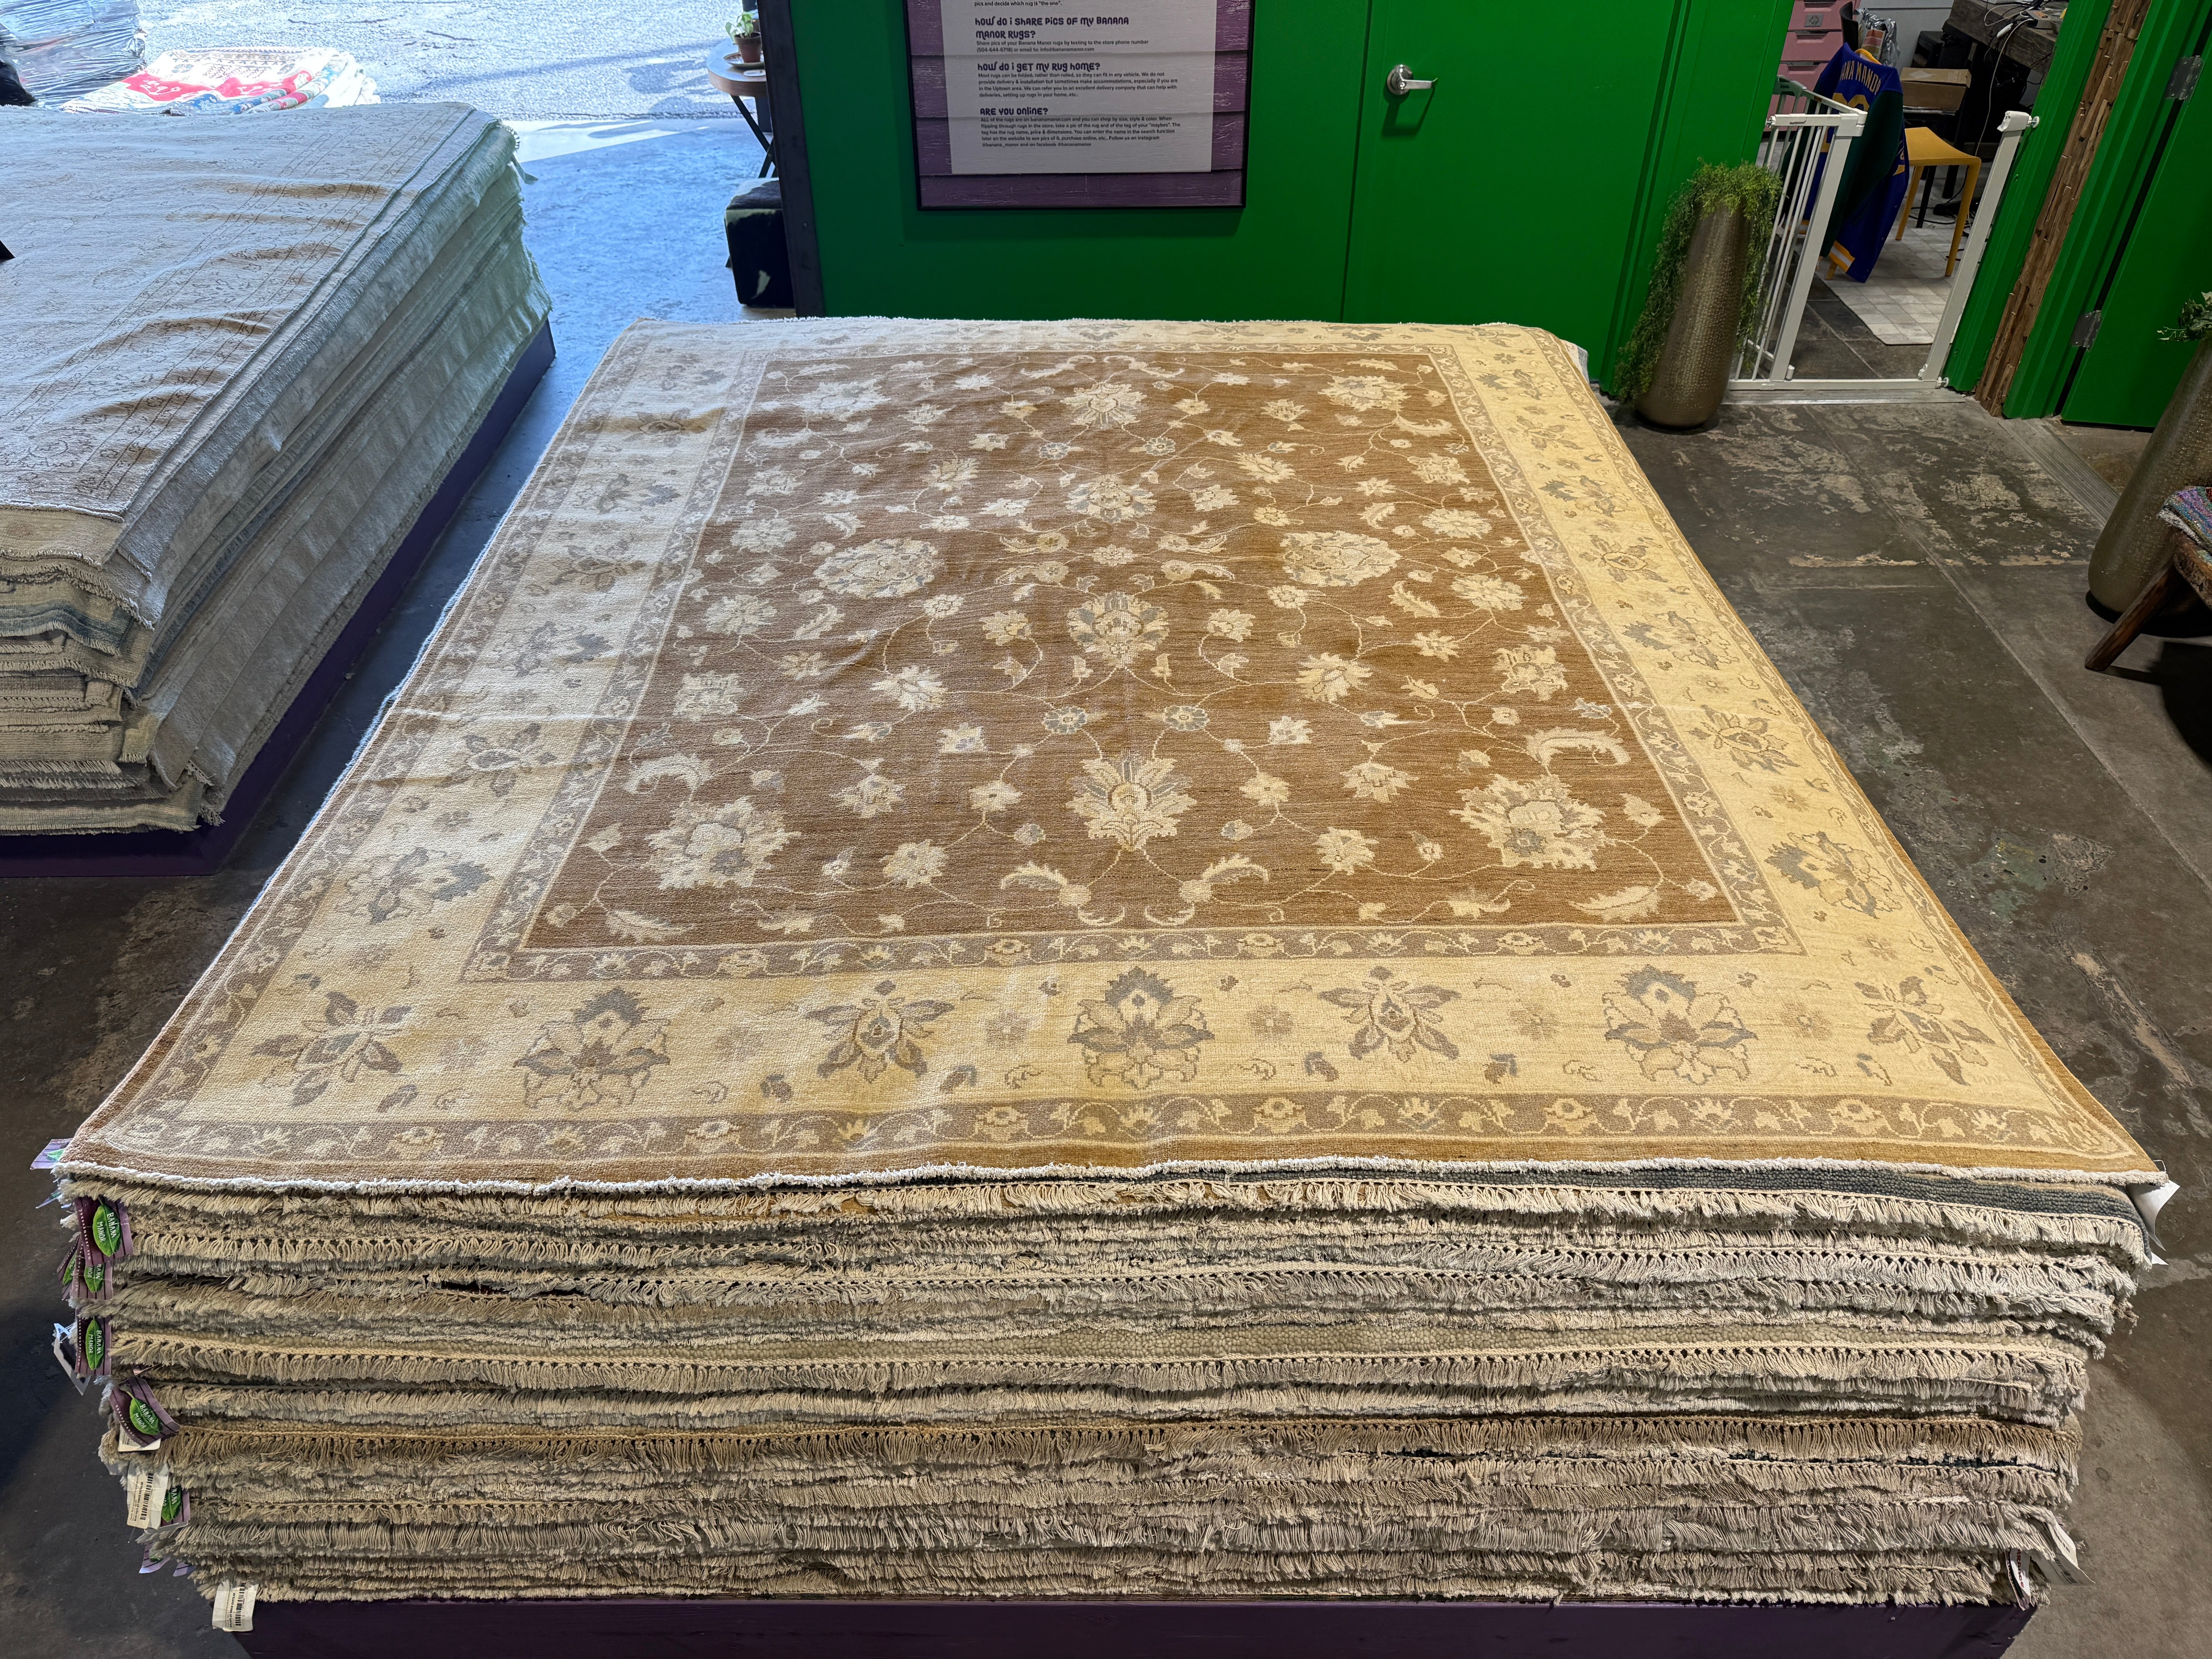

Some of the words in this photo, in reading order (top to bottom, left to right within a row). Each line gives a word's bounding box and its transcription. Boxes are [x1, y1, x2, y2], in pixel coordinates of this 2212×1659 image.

[1840, 60, 1855, 81] ANA
[96, 1221, 106, 1242] MANOR
[106, 1212, 117, 1238] BANANA
[133, 1412, 147, 1429] MANOR
[139, 1403, 156, 1424] BANANA
